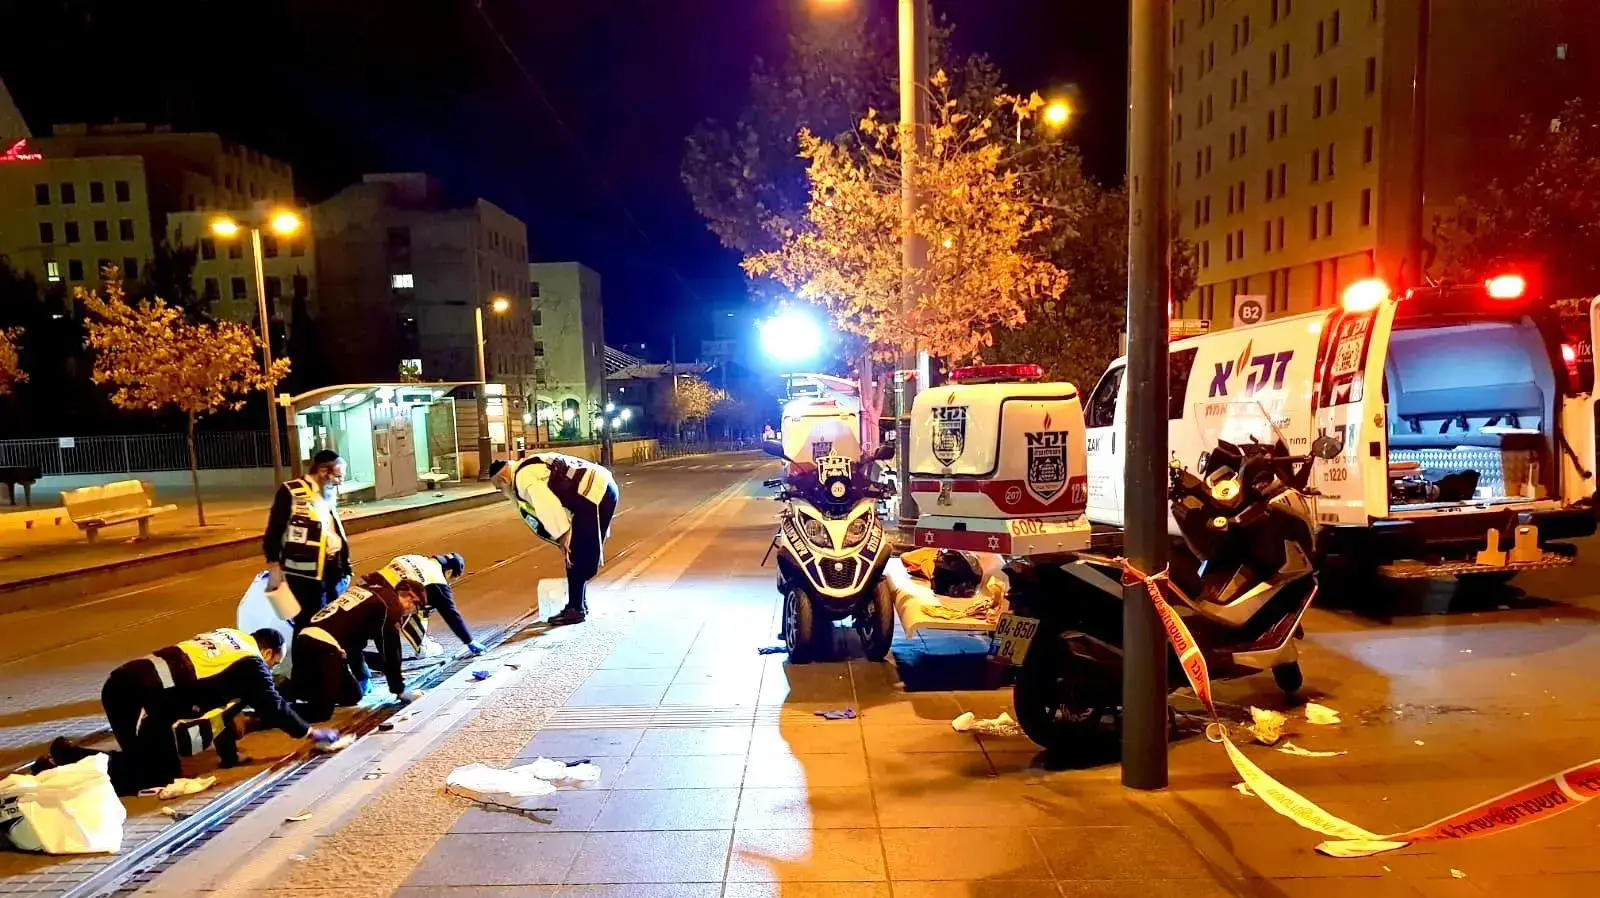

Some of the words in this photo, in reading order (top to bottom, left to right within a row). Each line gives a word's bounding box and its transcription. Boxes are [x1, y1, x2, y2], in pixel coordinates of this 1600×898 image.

[1242, 306, 1260, 319] B2
[1328, 467, 1348, 481] 1220
[1006, 491, 1020, 500] 207
[1011, 518, 1047, 536] 6002
